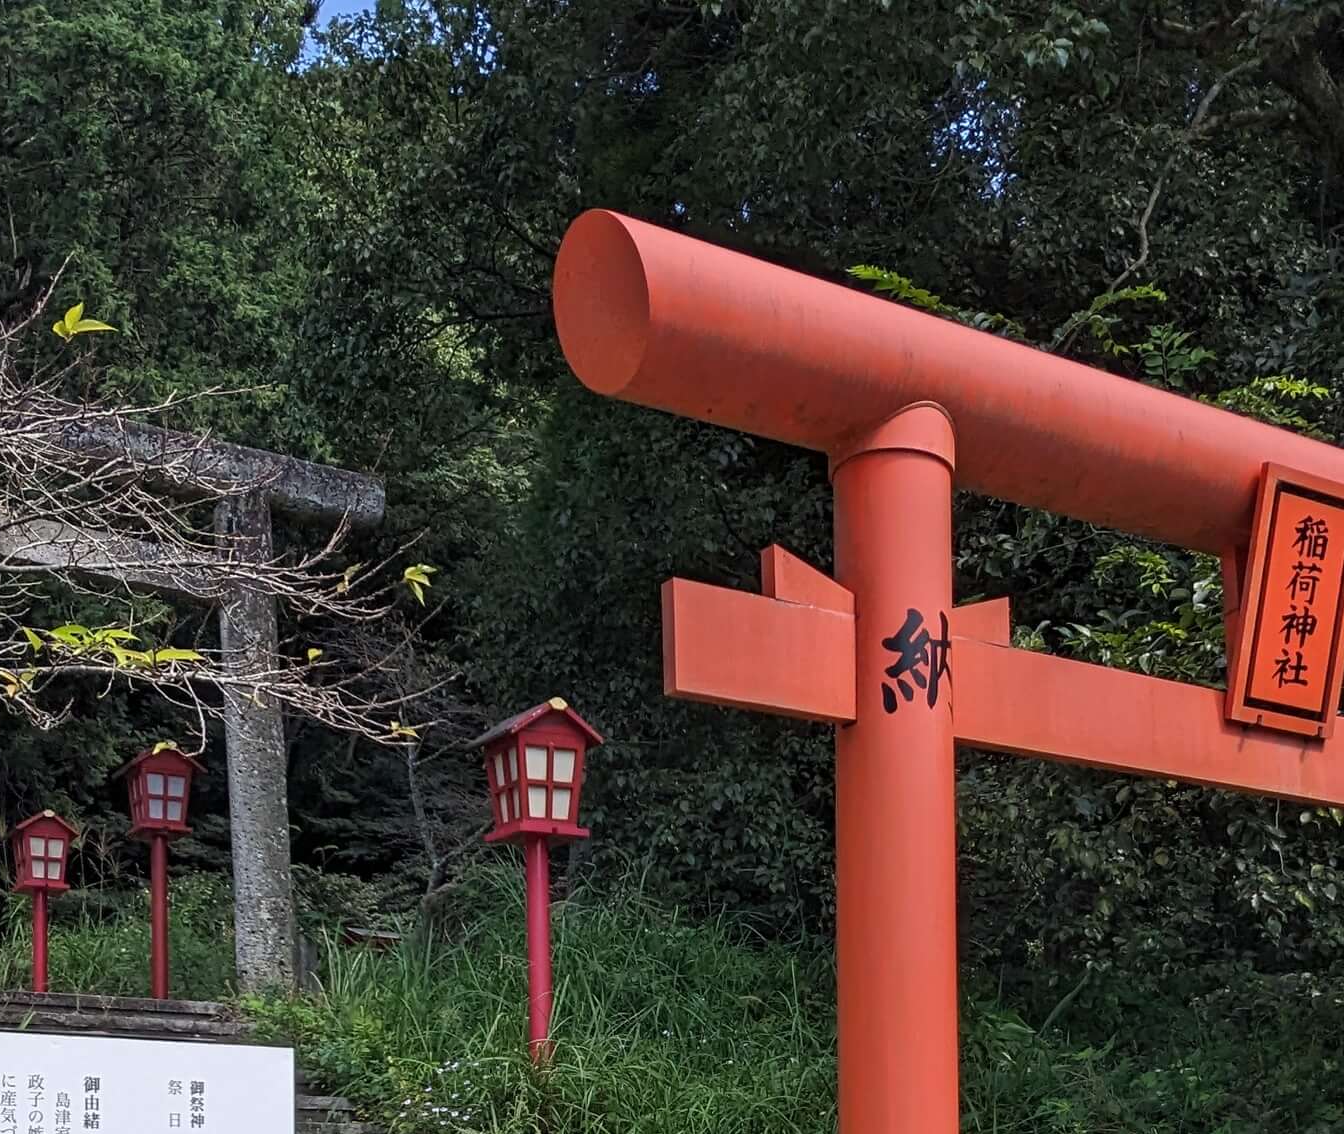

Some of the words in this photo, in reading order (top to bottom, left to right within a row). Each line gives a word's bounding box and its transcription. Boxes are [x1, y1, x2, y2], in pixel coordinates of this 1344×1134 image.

[1271, 515, 1329, 688] 稲荷神社
[881, 608, 954, 726] 納
[82, 1075, 101, 1130] 御由緒
[189, 1080, 205, 1129] 御祭神
